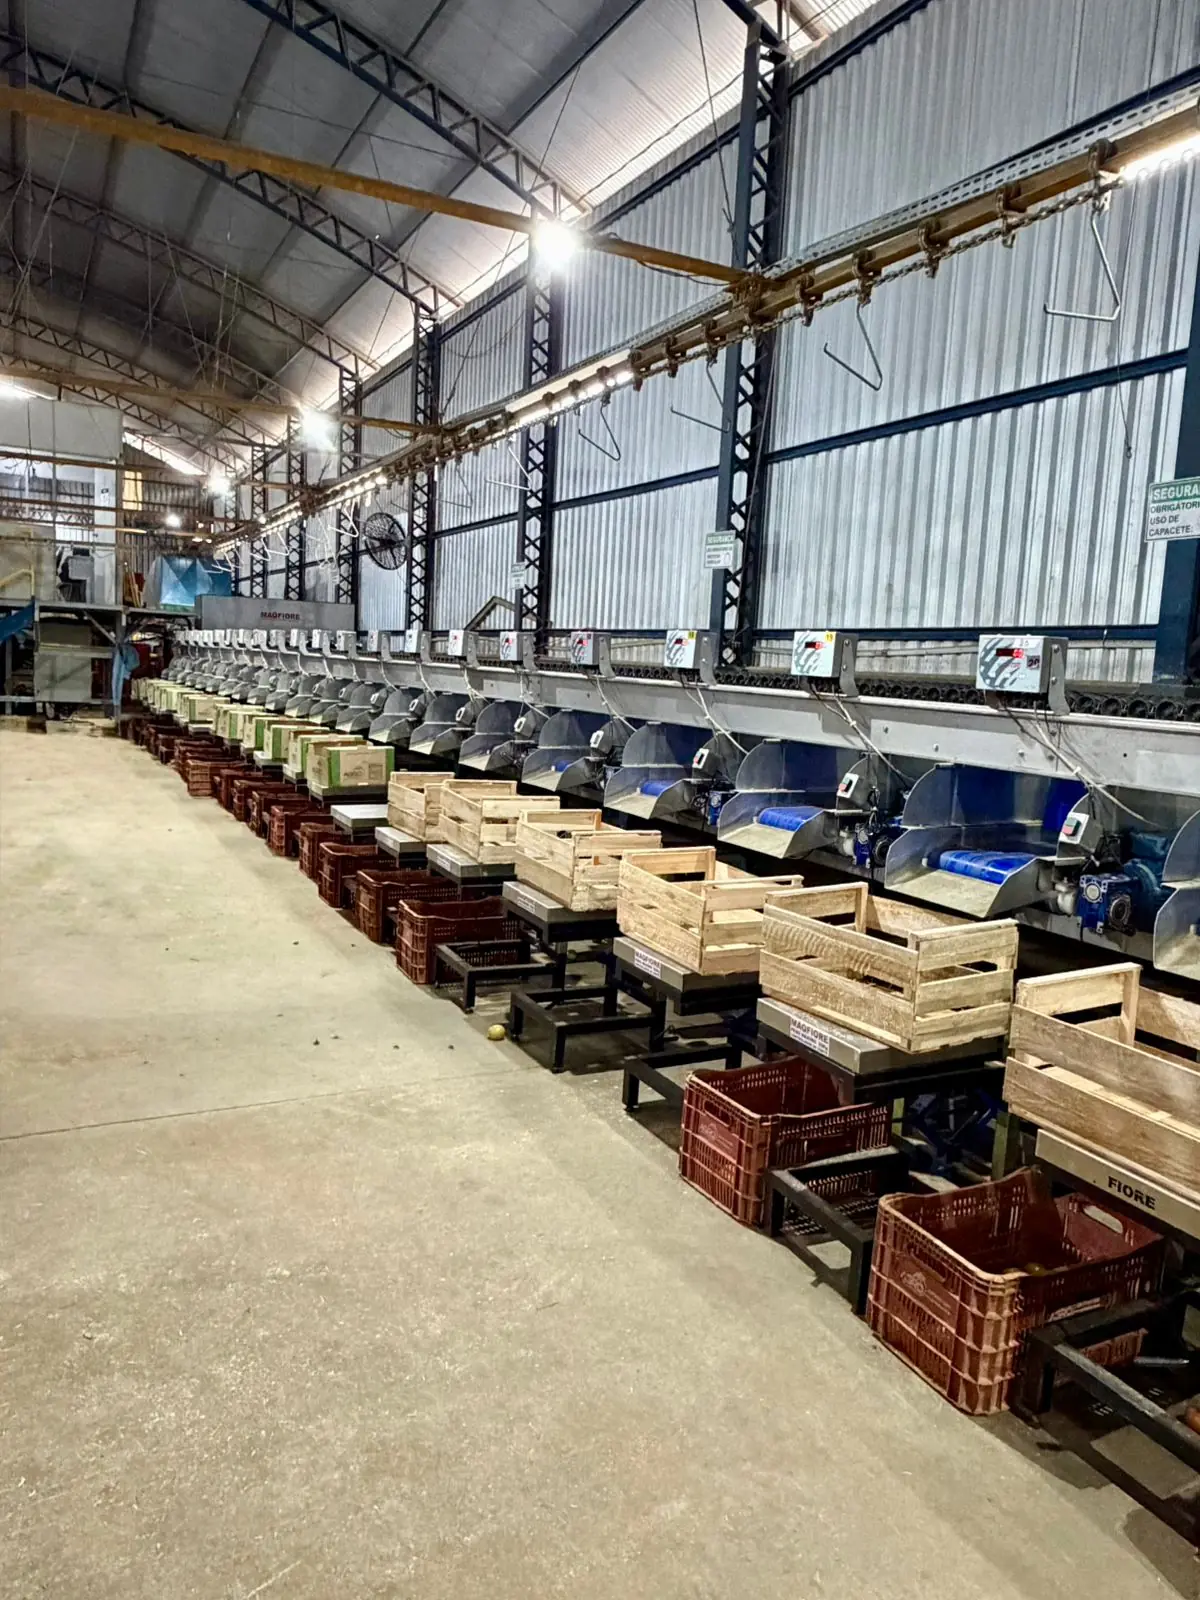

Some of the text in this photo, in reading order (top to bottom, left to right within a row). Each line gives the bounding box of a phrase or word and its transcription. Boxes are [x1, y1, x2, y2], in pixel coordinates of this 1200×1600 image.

[1150, 514, 1180, 525] USO DE
[1108, 1176, 1156, 1211] FIORE
